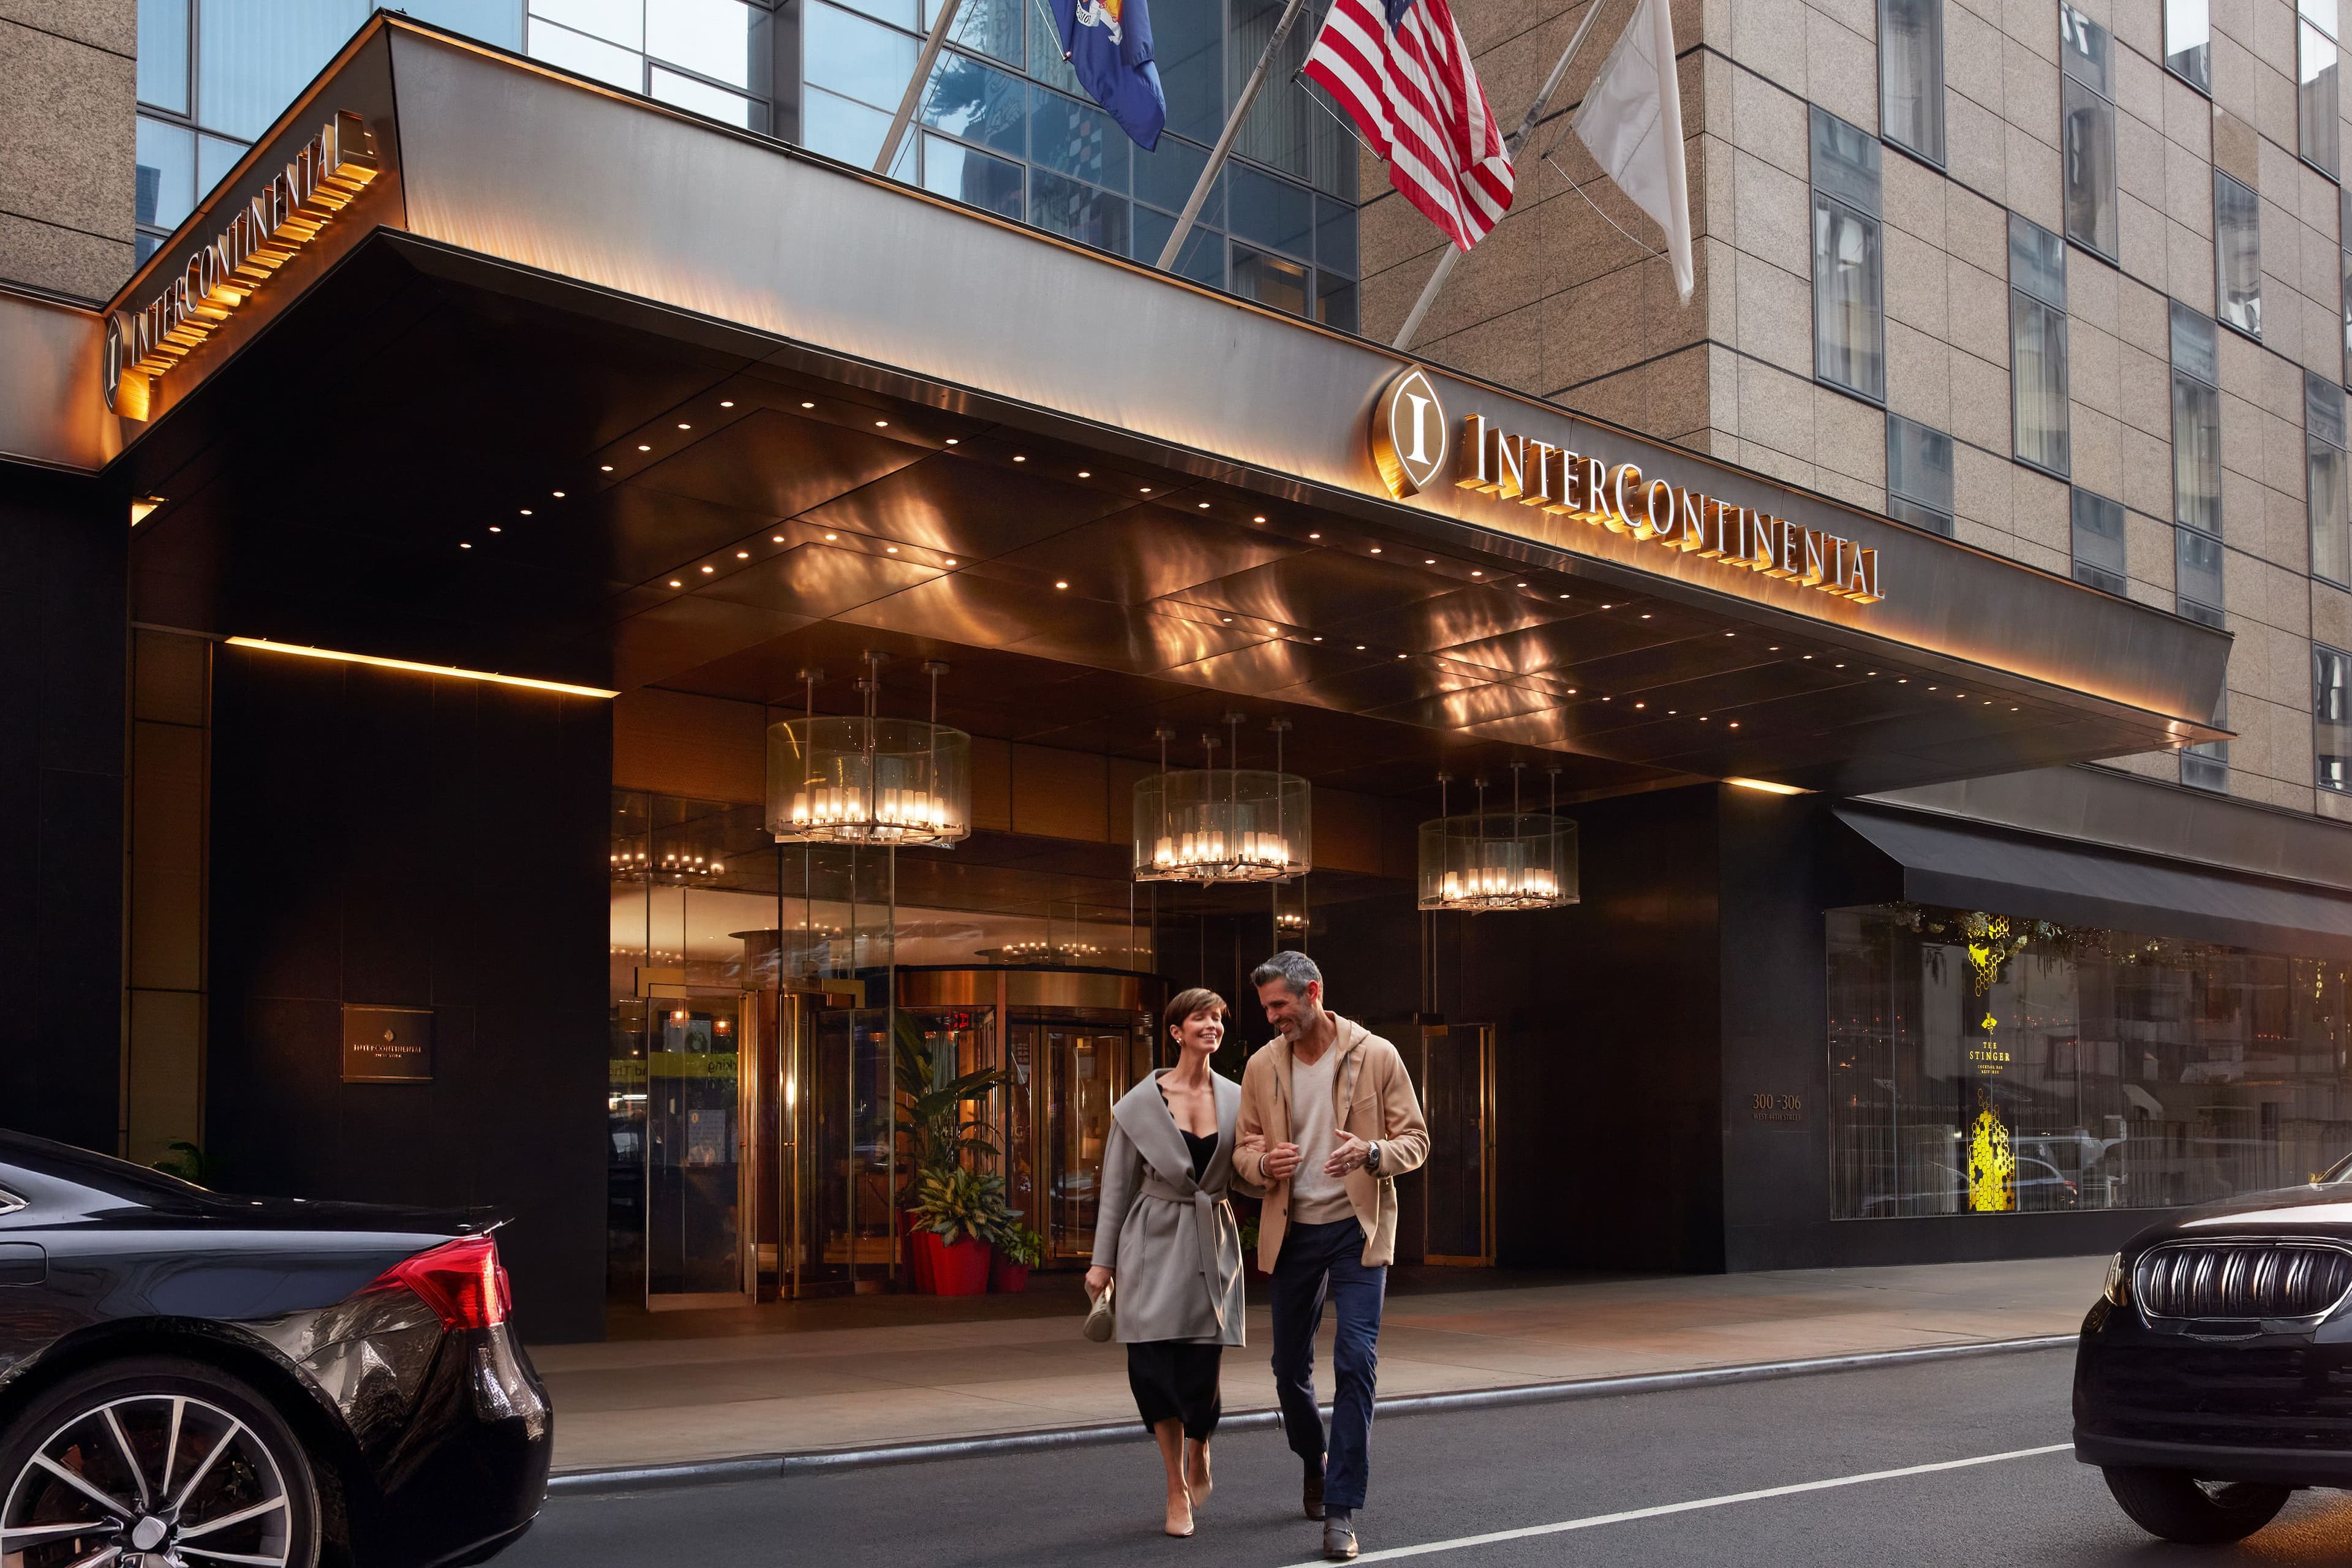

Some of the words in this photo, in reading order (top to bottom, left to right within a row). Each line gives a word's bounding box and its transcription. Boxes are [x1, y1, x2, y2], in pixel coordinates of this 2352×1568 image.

[1471, 413, 1886, 600] INTERCONTINENTAL
[1969, 1050, 2010, 1061] STINGER
[1753, 1093, 1773, 1109] 300
[1782, 1094, 1801, 1110] 306
